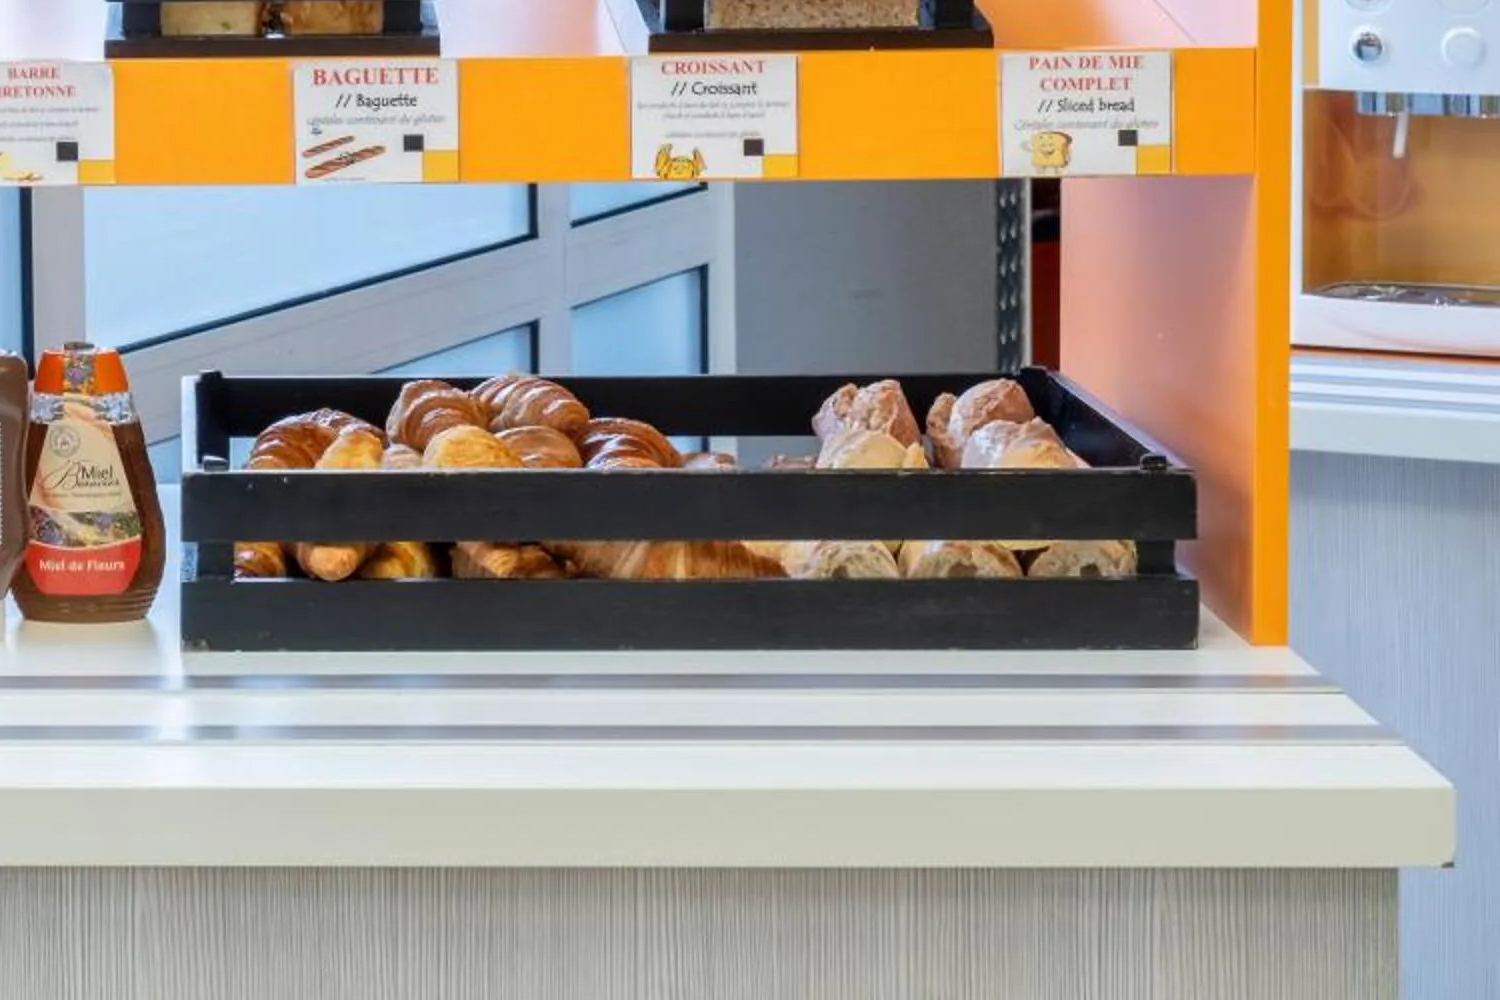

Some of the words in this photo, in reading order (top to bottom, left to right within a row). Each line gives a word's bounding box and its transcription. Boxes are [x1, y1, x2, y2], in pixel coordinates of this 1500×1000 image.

[661, 60, 766, 75] CROISSANT
[1029, 55, 1072, 70] PAIN
[1079, 55, 1101, 69] DE
[1108, 55, 1144, 69] MIE
[8, 67, 60, 80] BARRE
[312, 67, 439, 85] BAGUETTE
[691, 81, 758, 96] Croissant
[1040, 77, 1133, 91] COMPLET
[356, 93, 418, 112] Baguette
[1057, 97, 1094, 113] Sliced
[1099, 97, 1135, 112] bread
[81, 464, 113, 480] Miel
[39, 559, 65, 571] Miel
[87, 559, 126, 571] Fleurs
